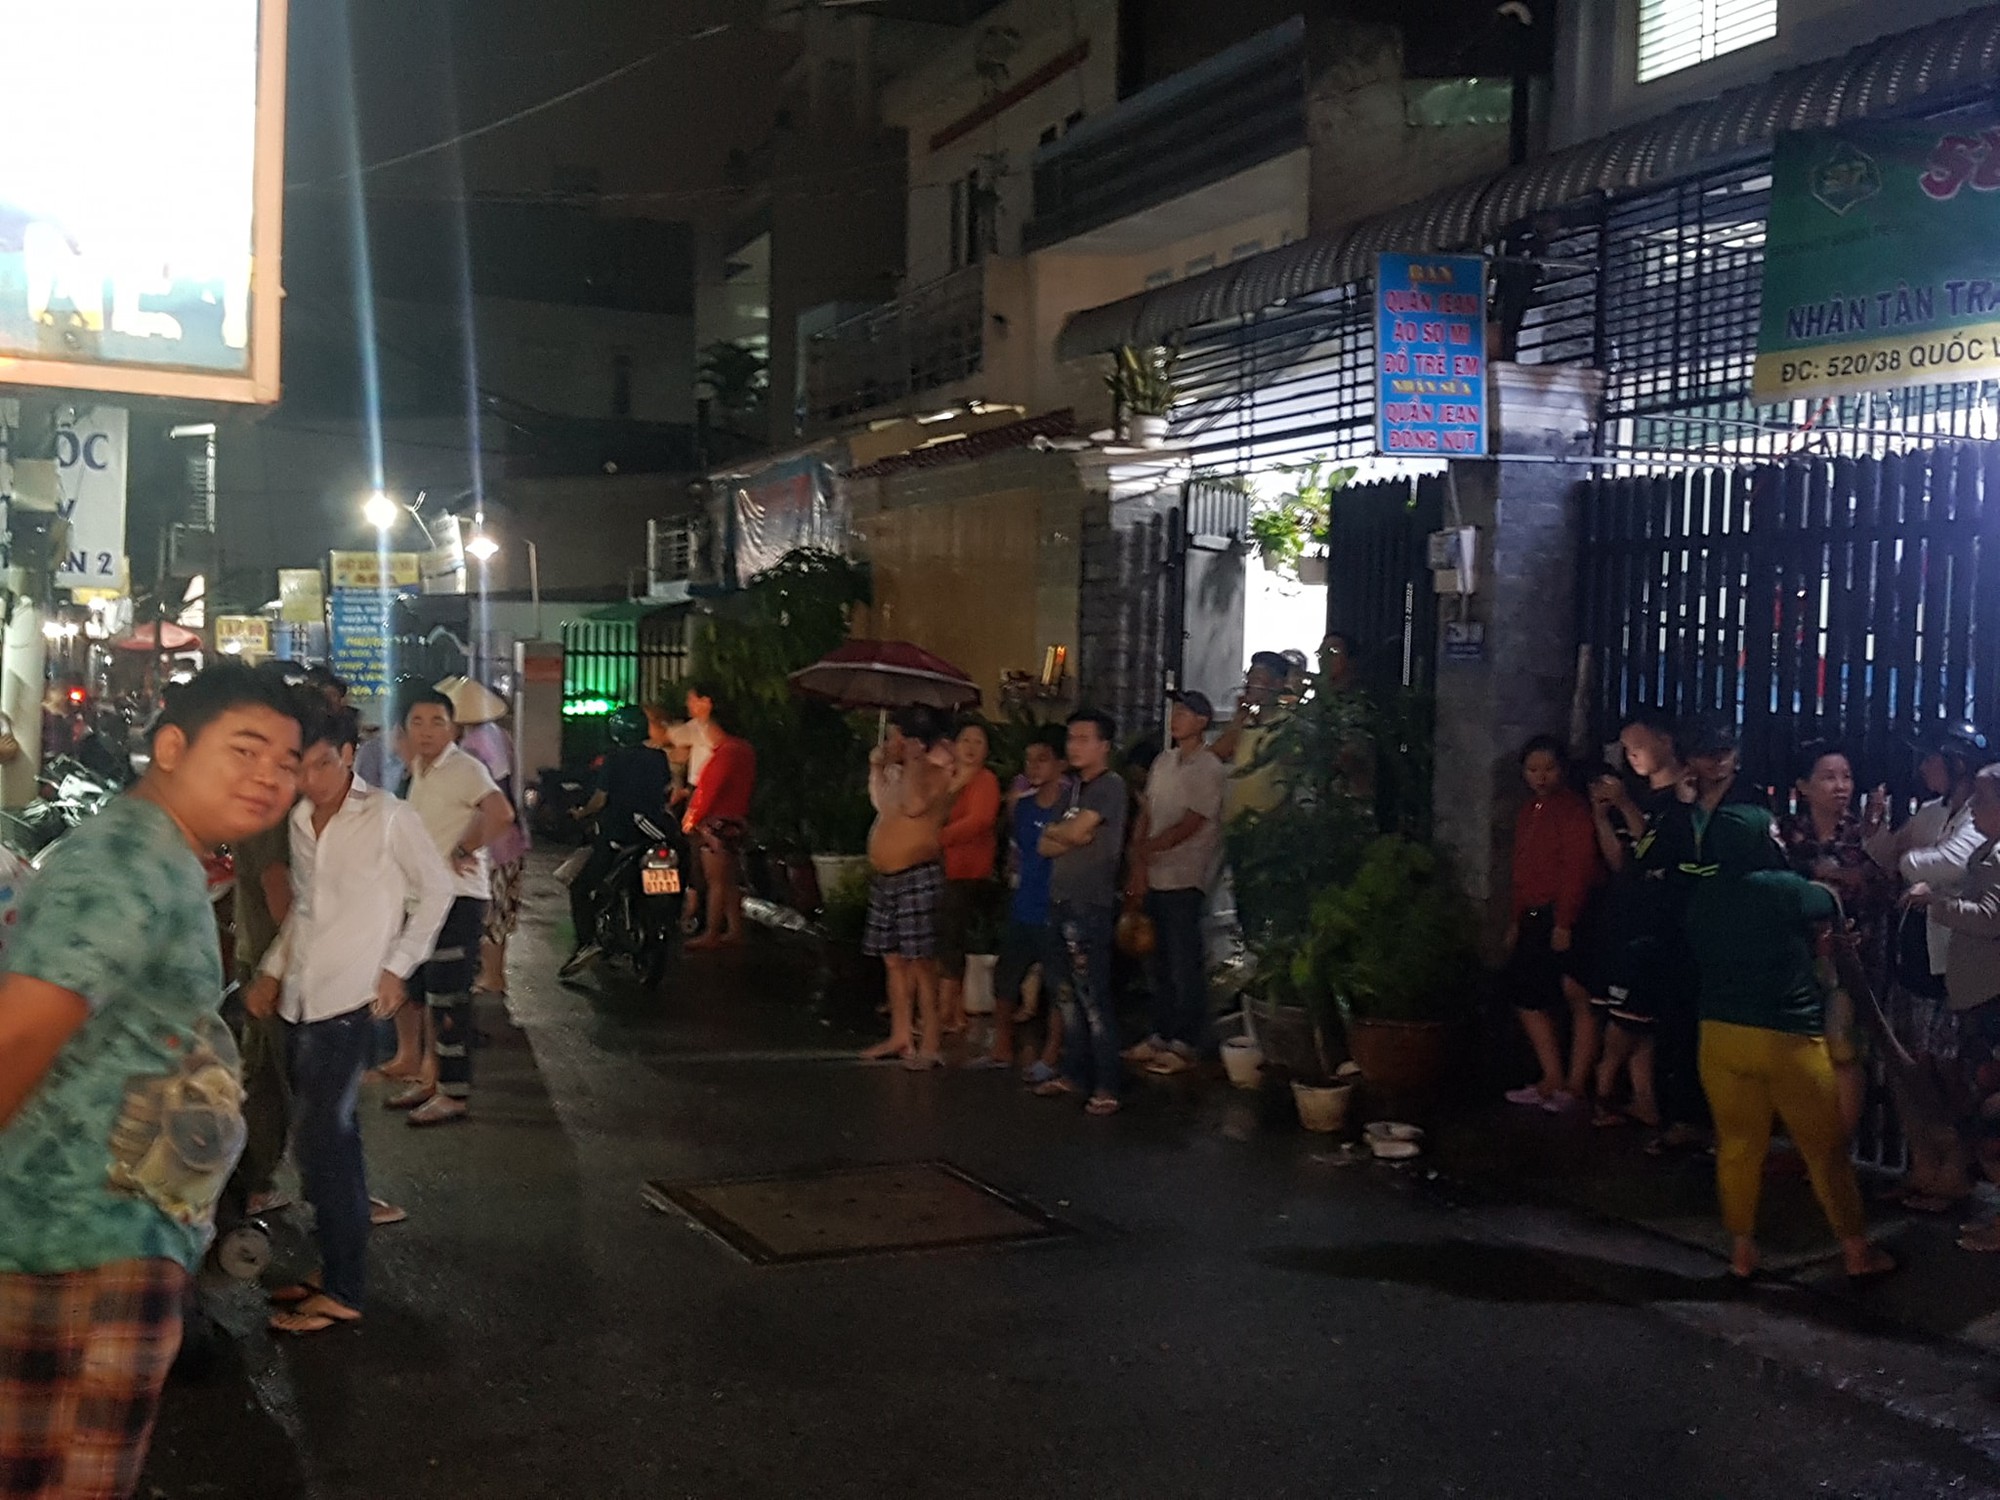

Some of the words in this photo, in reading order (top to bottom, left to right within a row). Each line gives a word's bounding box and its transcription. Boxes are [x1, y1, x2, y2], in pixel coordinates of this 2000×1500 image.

[1781, 360, 1820, 383] ĐC:
[1825, 349, 1902, 378] 520/38
[1909, 331, 1984, 367] QUỐC
